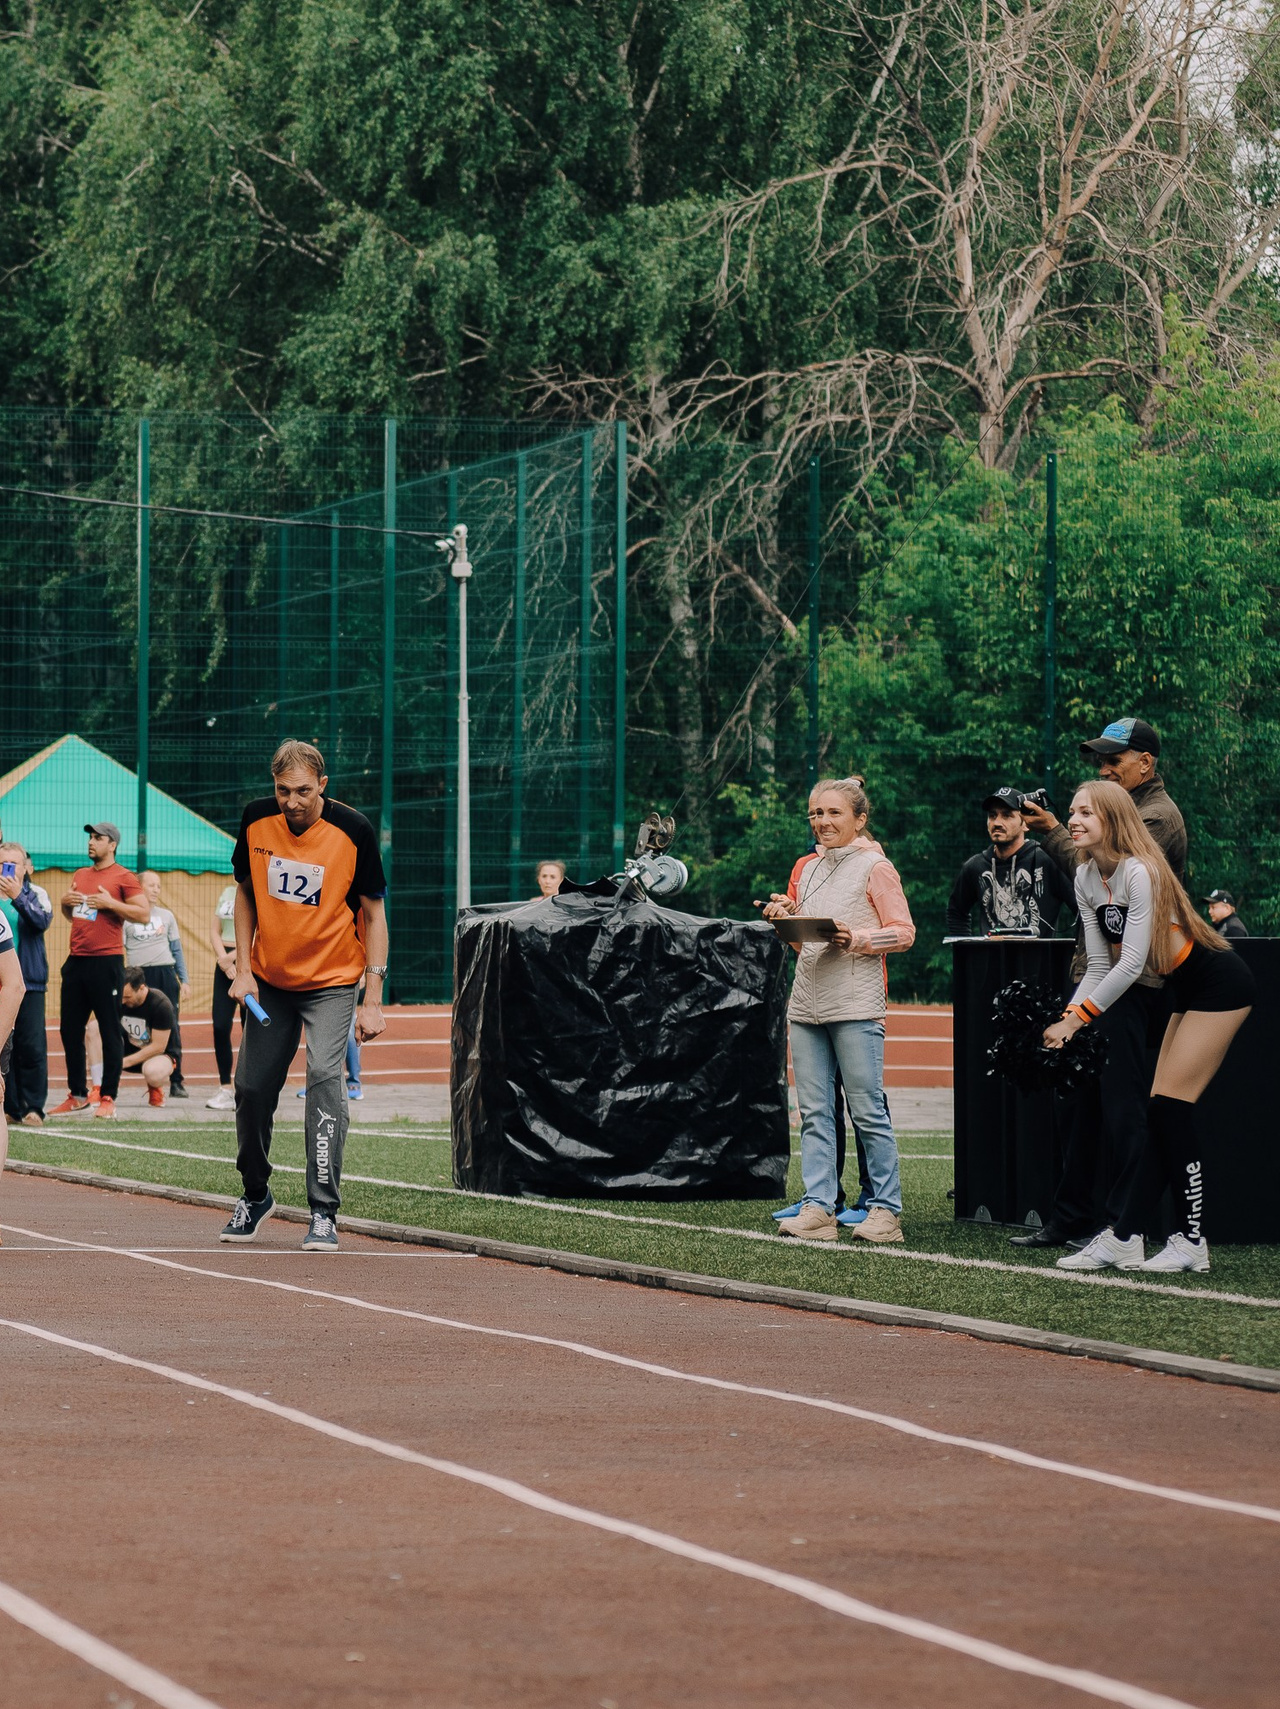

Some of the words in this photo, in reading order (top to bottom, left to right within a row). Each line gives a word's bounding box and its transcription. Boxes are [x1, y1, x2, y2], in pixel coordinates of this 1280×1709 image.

[277, 871, 309, 898] 12
[310, 895, 317, 905] 1
[127, 1023, 141, 1037] 10
[316, 1132, 329, 1185] JORDAN
[1184, 1160, 1203, 1239] winline
